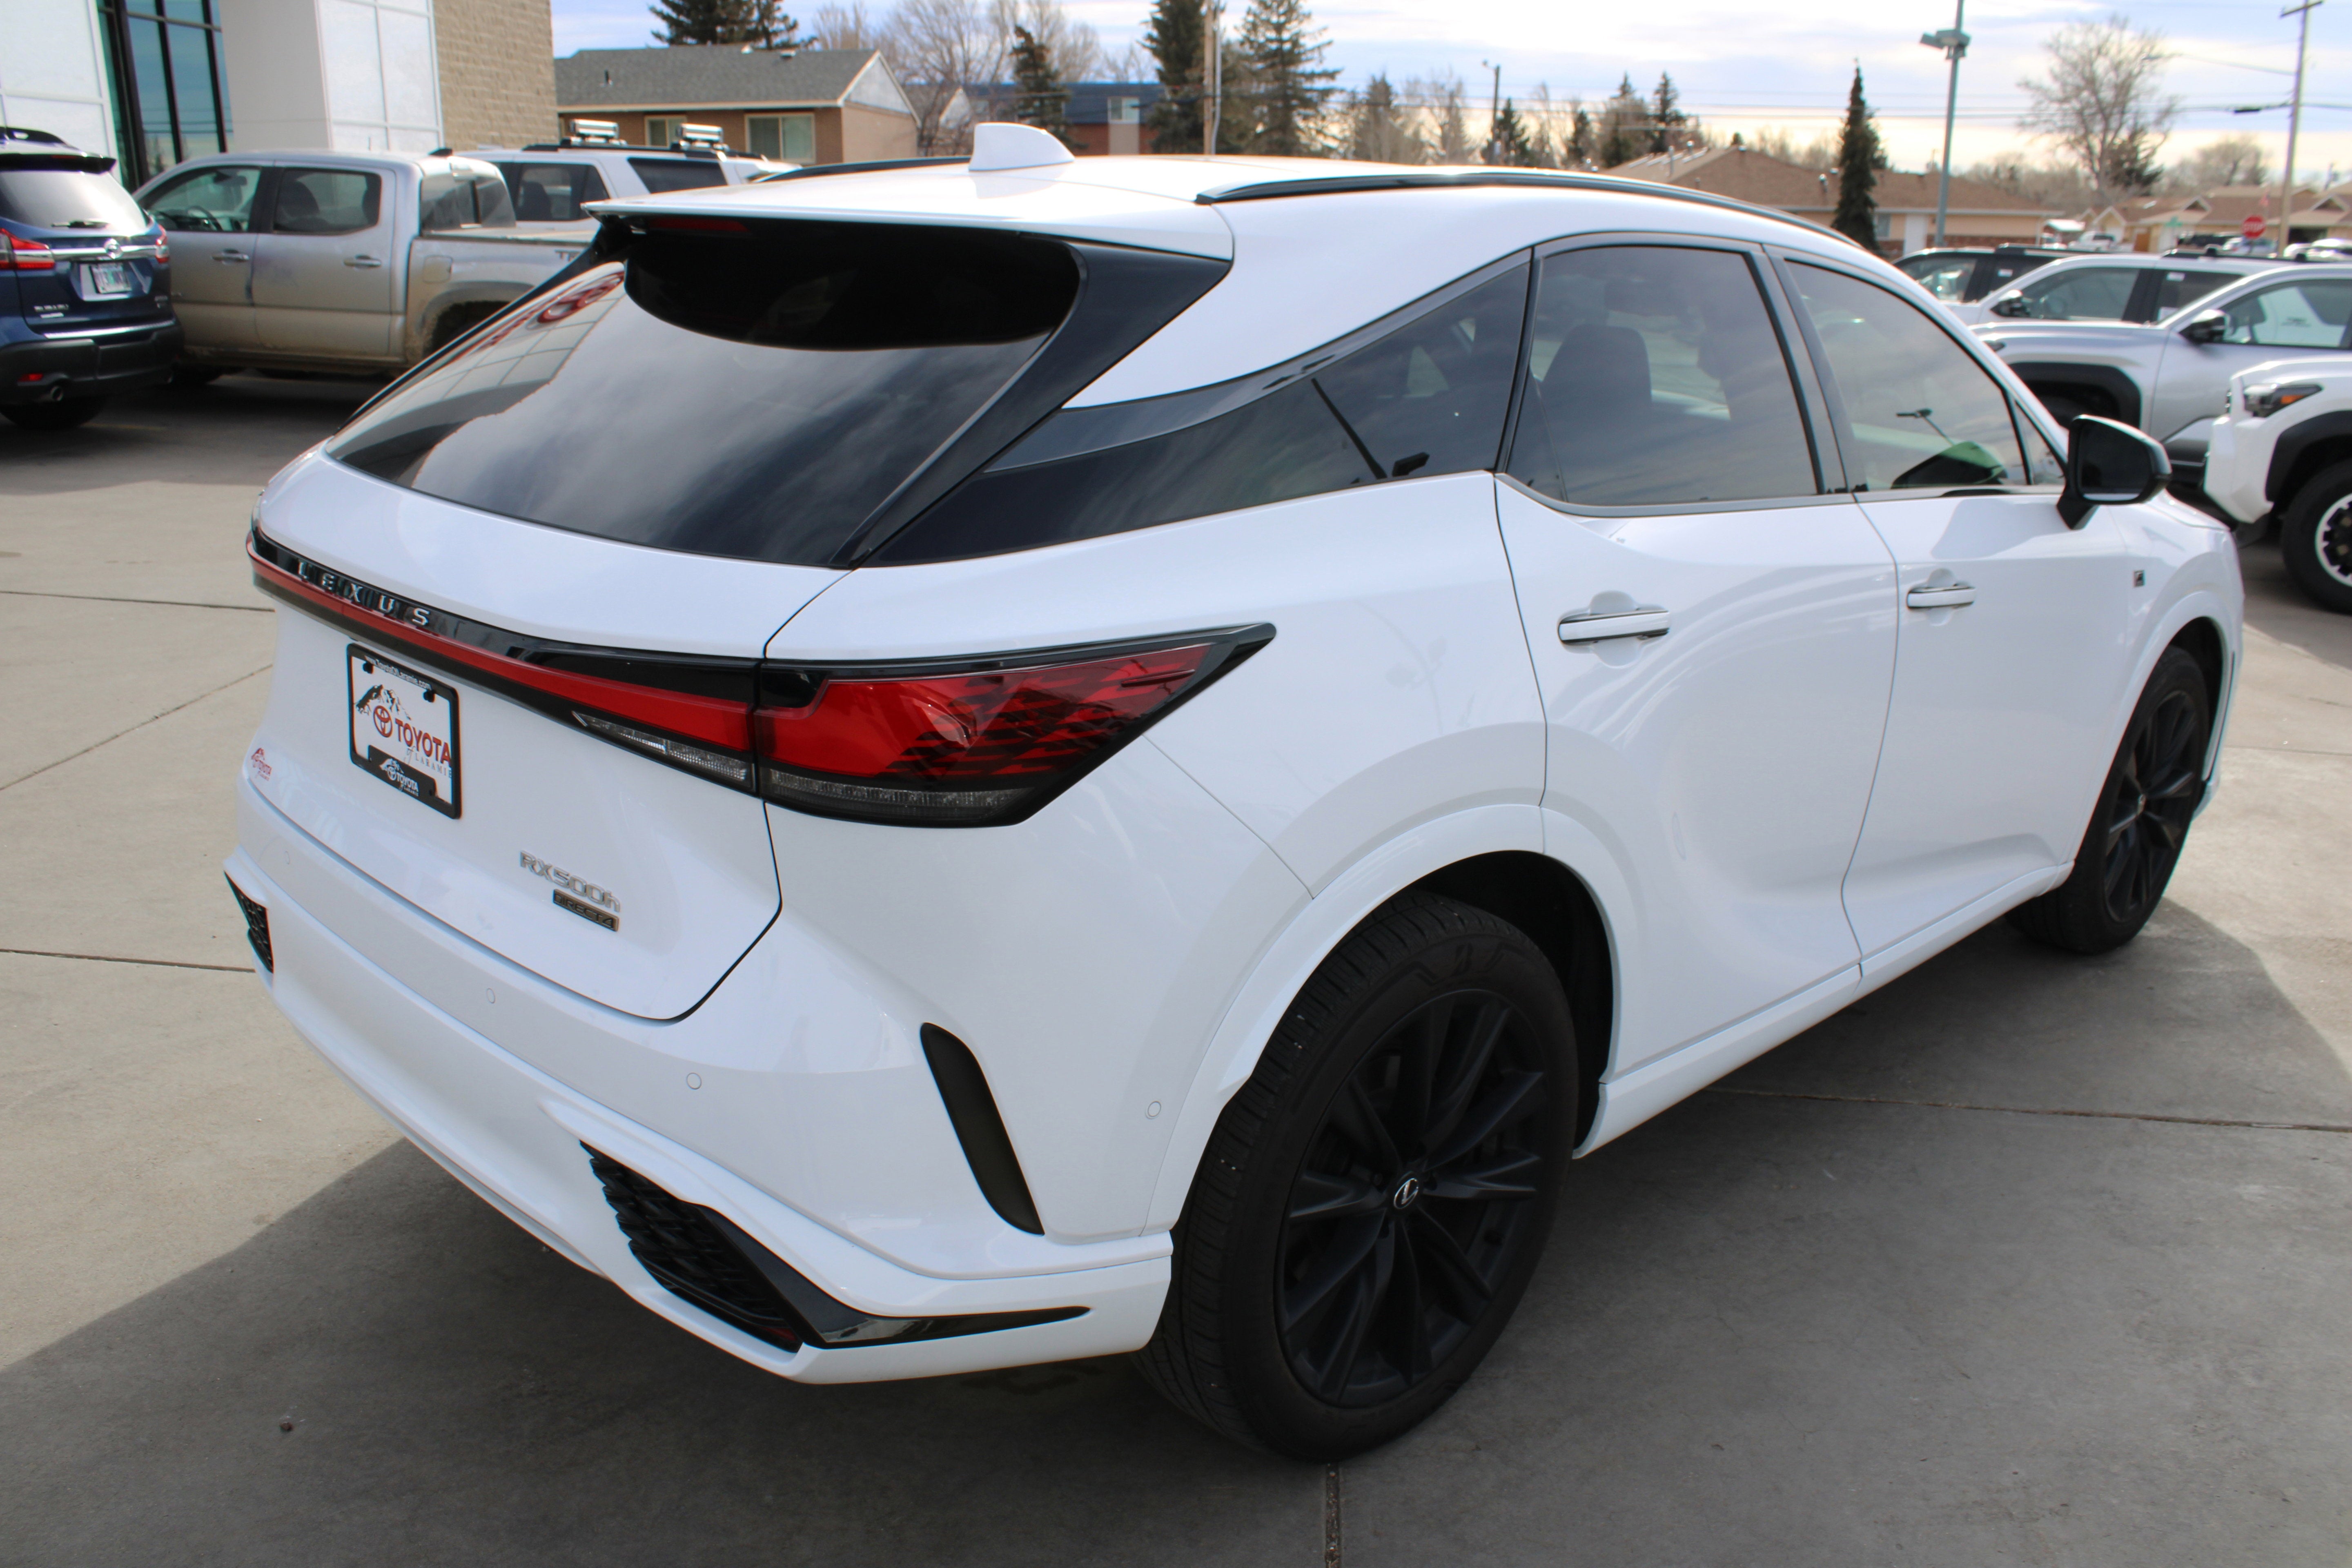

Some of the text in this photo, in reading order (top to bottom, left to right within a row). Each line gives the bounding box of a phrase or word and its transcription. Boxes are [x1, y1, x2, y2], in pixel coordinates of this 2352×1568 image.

[298, 561, 430, 626] LEXUS
[395, 718, 452, 767] TOYOTA
[415, 753, 452, 778] LARAMIE
[396, 772, 419, 792] TOYOTA
[520, 850, 621, 913] RX500h
